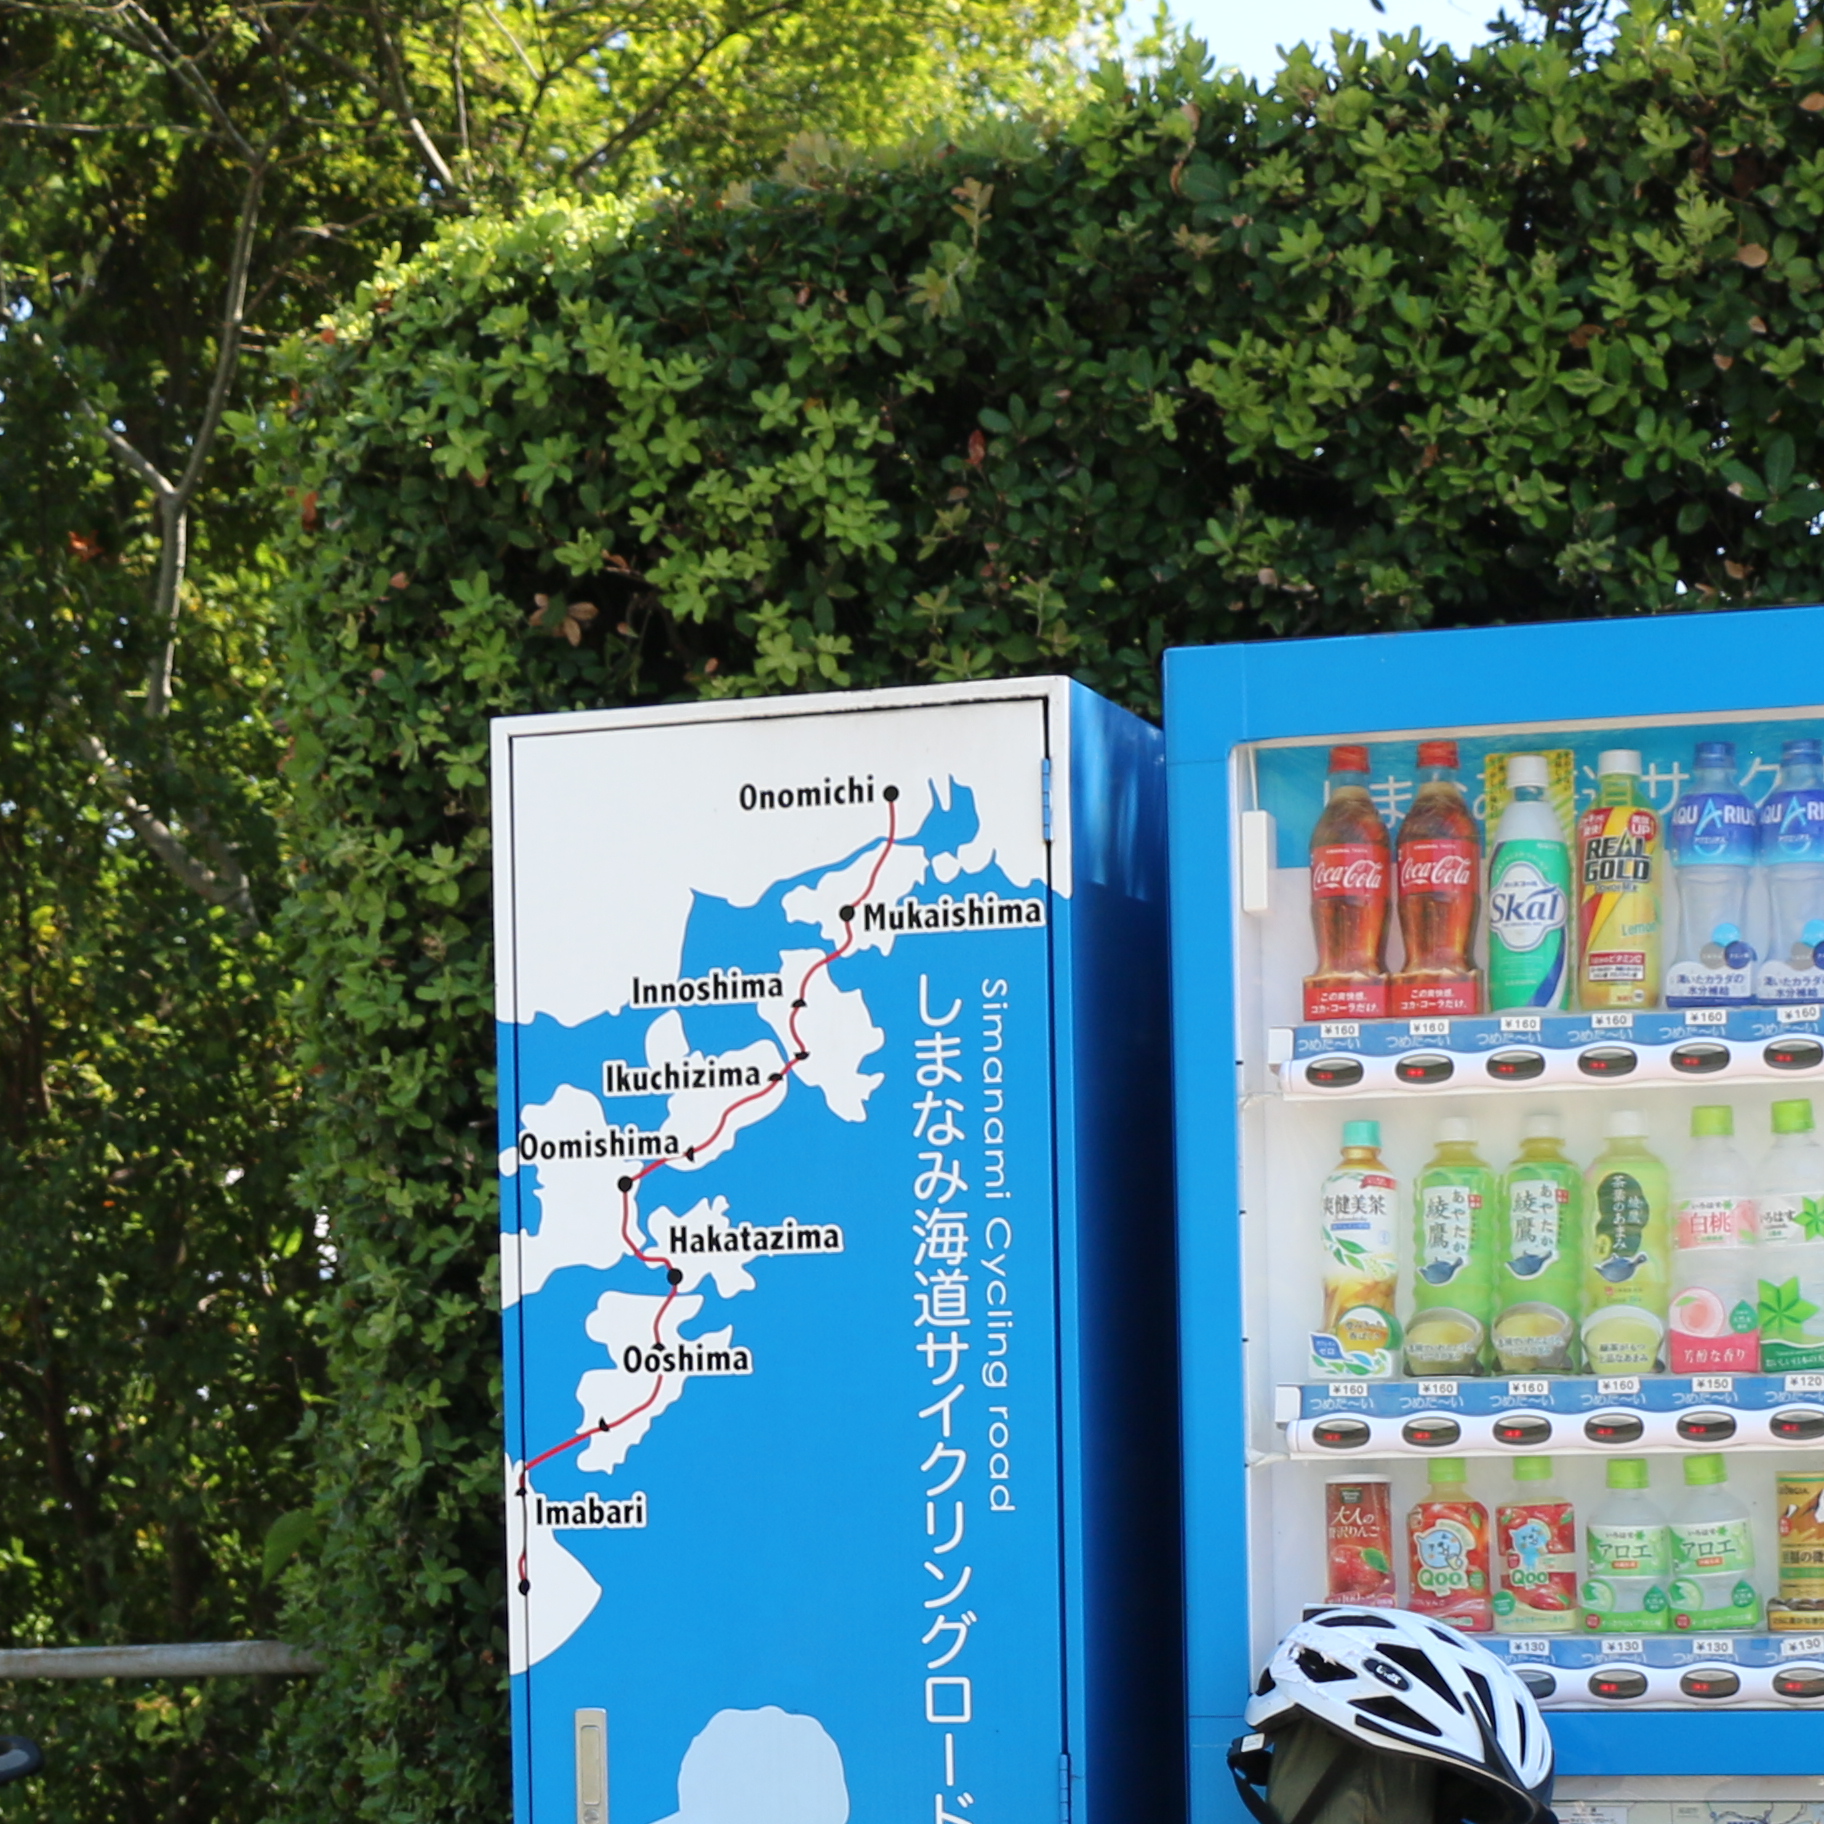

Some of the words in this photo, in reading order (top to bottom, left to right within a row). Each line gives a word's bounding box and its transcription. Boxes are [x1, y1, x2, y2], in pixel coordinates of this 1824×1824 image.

[739, 775, 874, 811] Onomichi
[1585, 831, 1649, 860] REAL
[1313, 858, 1383, 891] Coca-Cola
[1401, 855, 1470, 888] Coca-Cola
[1585, 857, 1651, 883] GOLD
[863, 900, 1042, 932] Mukaishima
[632, 971, 784, 1005] Innoshima
[1505, 1019, 1537, 1029] ¥160
[1595, 1015, 1627, 1025] ¥160
[1690, 1012, 1722, 1022] ¥160
[1785, 1007, 1816, 1020] ¥160
[1325, 1025, 1356, 1035] ¥160
[1413, 1022, 1445, 1033] ¥160
[605, 1062, 761, 1093] Ikuchizima
[981, 978, 1011, 1199] Simanami
[519, 1130, 679, 1161] Oomishima
[1426, 1196, 1451, 1250] 綾鷹
[1451, 1190, 1468, 1252] あやたか
[1512, 1190, 1537, 1244] 綾鷹
[1540, 1184, 1555, 1248] あやたか
[1690, 1212, 1732, 1234] 白桃
[670, 1225, 840, 1254] Hakatazima
[980, 1217, 1014, 1388] Cycling
[623, 1343, 749, 1373] Ooshima
[1333, 1384, 1364, 1395] ¥160
[1422, 1382, 1454, 1393] ¥160
[1512, 1381, 1544, 1393] ¥160
[1602, 1379, 1634, 1391] ¥160
[1697, 1378, 1729, 1390] ¥150
[1790, 1376, 1822, 1388] ¥120
[989, 1407, 1016, 1512] road
[535, 1496, 644, 1526] Imabari
[1331, 1506, 1375, 1525] 大人の
[1599, 1543, 1652, 1559] アロエ
[1682, 1539, 1736, 1557] アロエ
[1418, 1569, 1463, 1588] Qoo
[1512, 1569, 1549, 1586] Qoo
[1607, 1640, 1639, 1651] ¥130
[1788, 1638, 1821, 1652] ¥130
